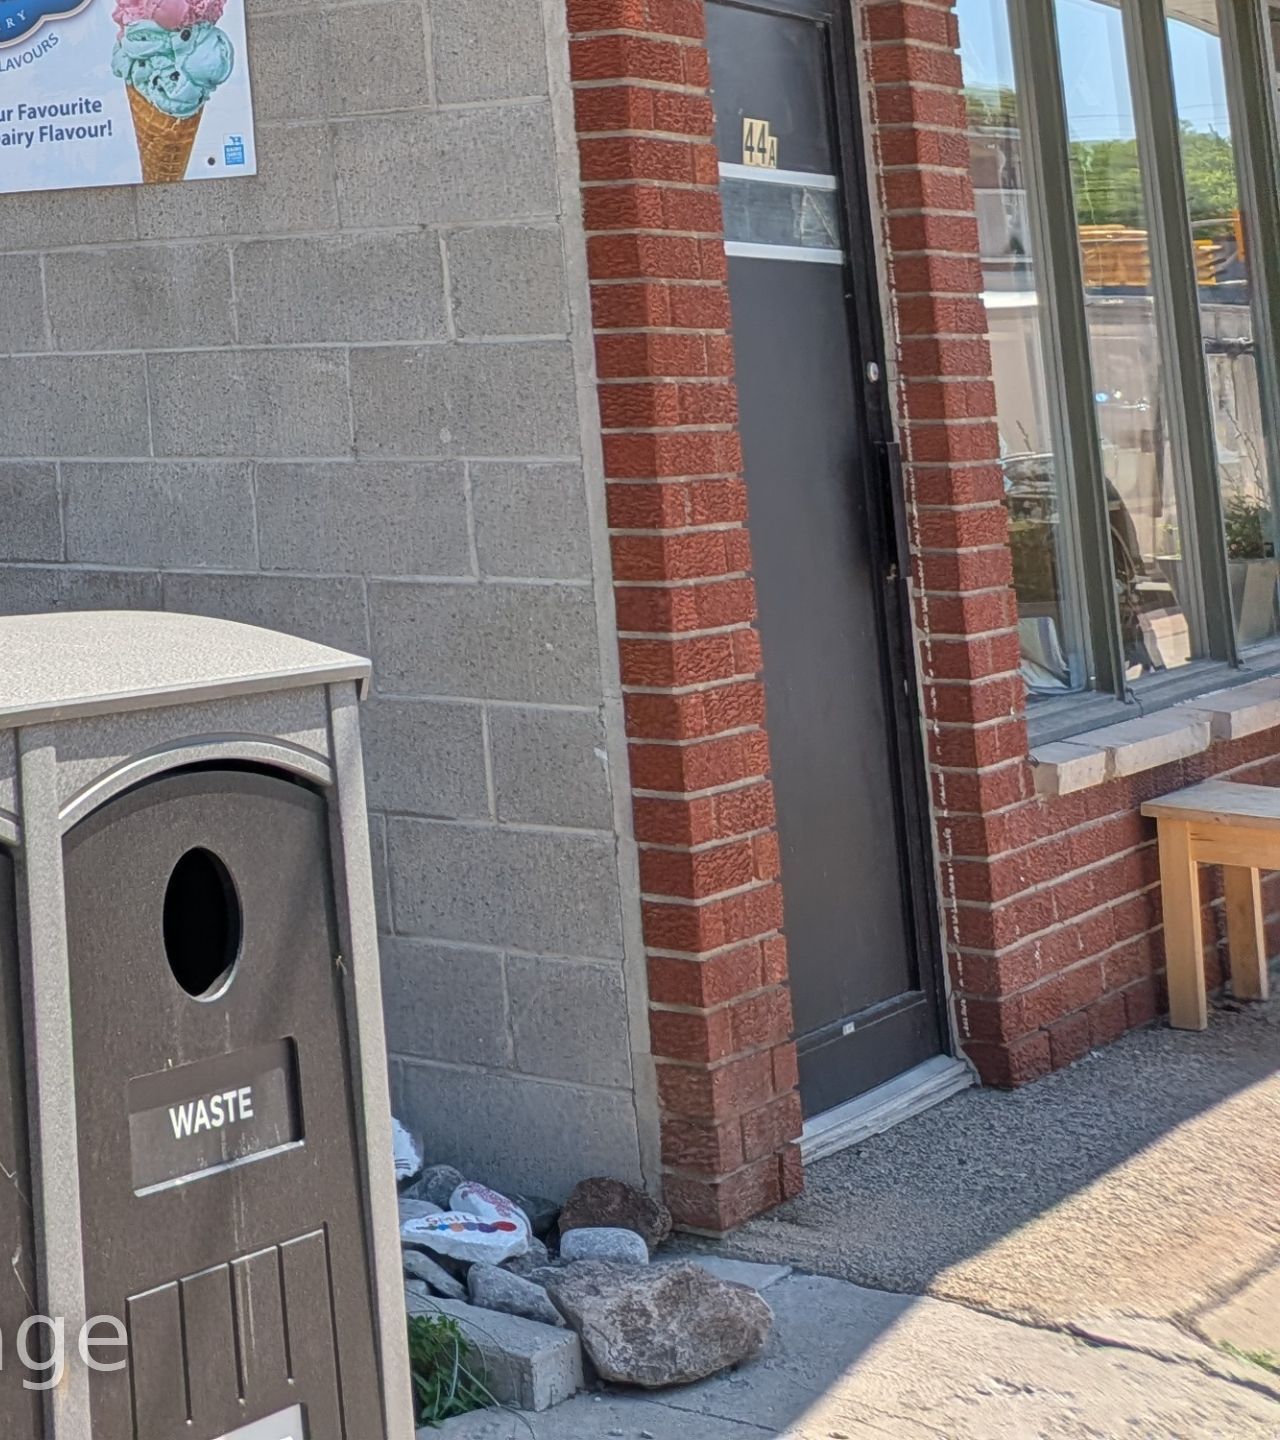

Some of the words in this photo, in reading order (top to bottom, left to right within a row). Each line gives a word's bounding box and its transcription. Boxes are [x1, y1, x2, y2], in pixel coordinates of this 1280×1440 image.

[18, 97, 103, 120] Favourite
[39, 119, 113, 142] Flavour!
[168, 1086, 254, 1139] WASTE
